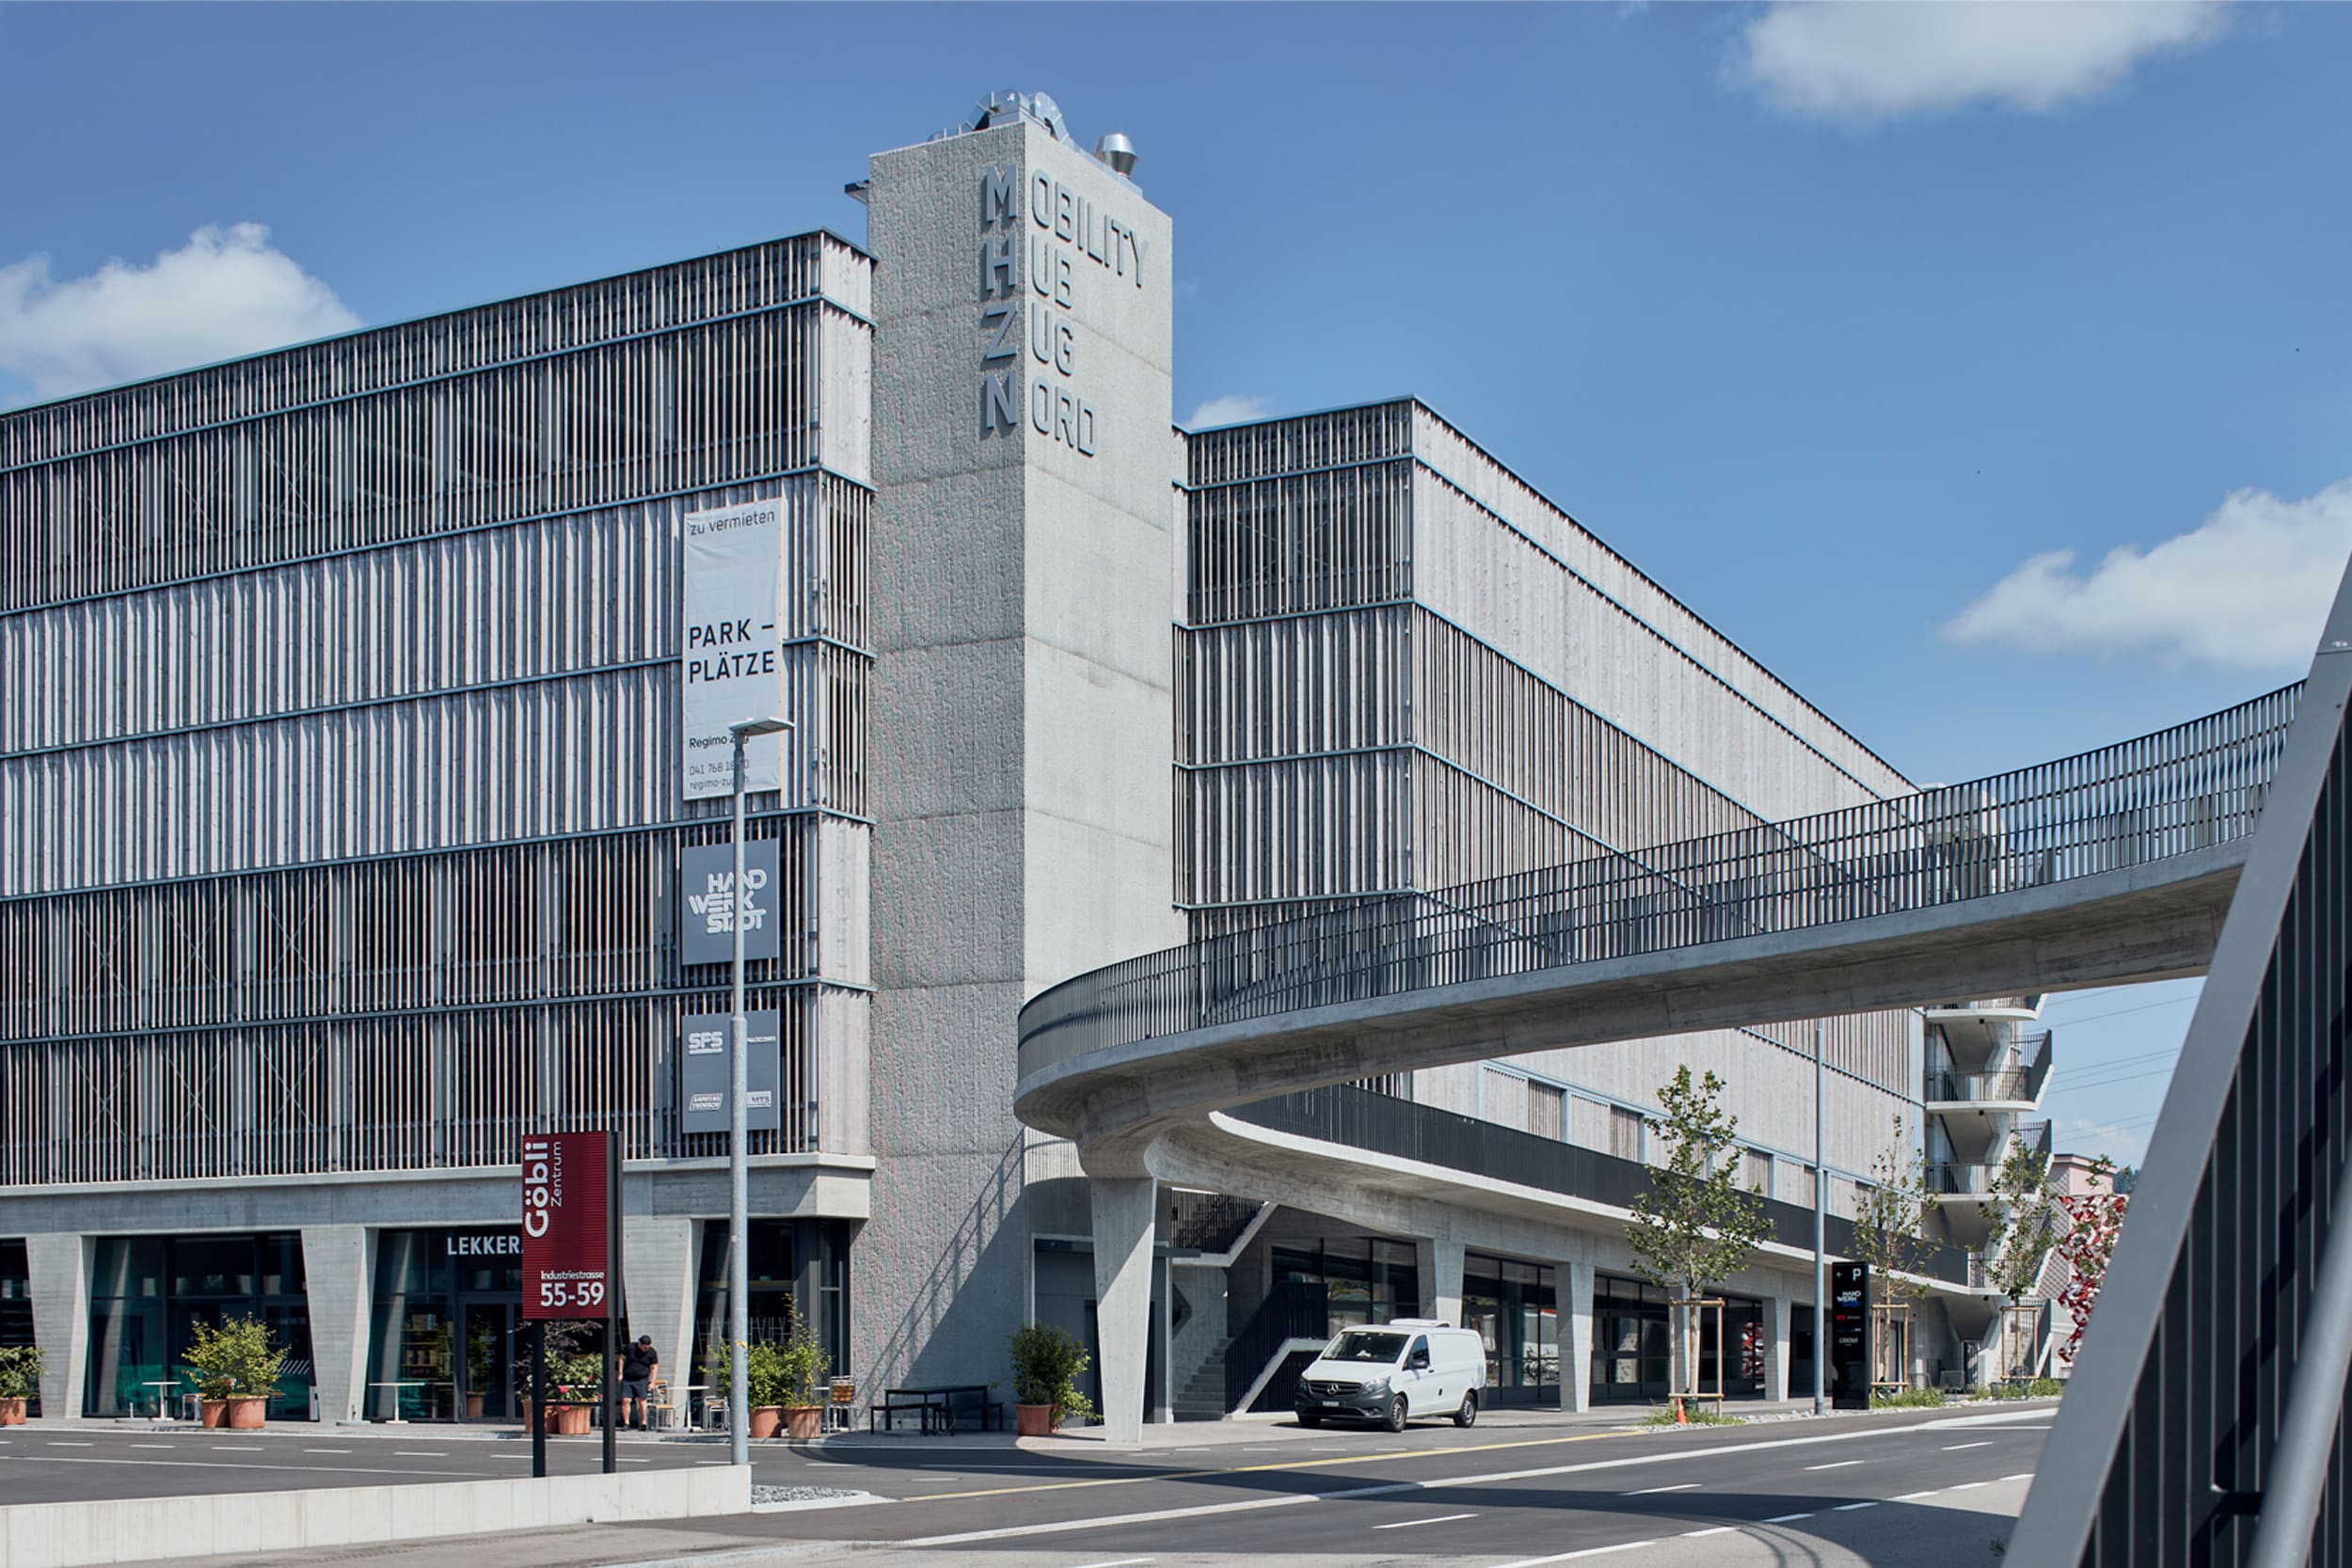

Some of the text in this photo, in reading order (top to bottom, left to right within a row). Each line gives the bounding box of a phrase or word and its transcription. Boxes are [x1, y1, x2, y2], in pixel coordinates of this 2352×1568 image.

[690, 511, 775, 536] zu vermieten
[689, 651, 775, 685] PLÄTZE
[689, 736, 728, 750] Regimo
[689, 764, 706, 776] 041
[688, 1031, 723, 1049] SFS
[550, 1141, 563, 1208] Zentrum
[524, 1141, 549, 1238] Göbli
[447, 1235, 524, 1256] LEKKER
[540, 1270, 605, 1280] Industriestrasse
[1852, 1267, 1862, 1281] P
[540, 1281, 605, 1307] 55-59
